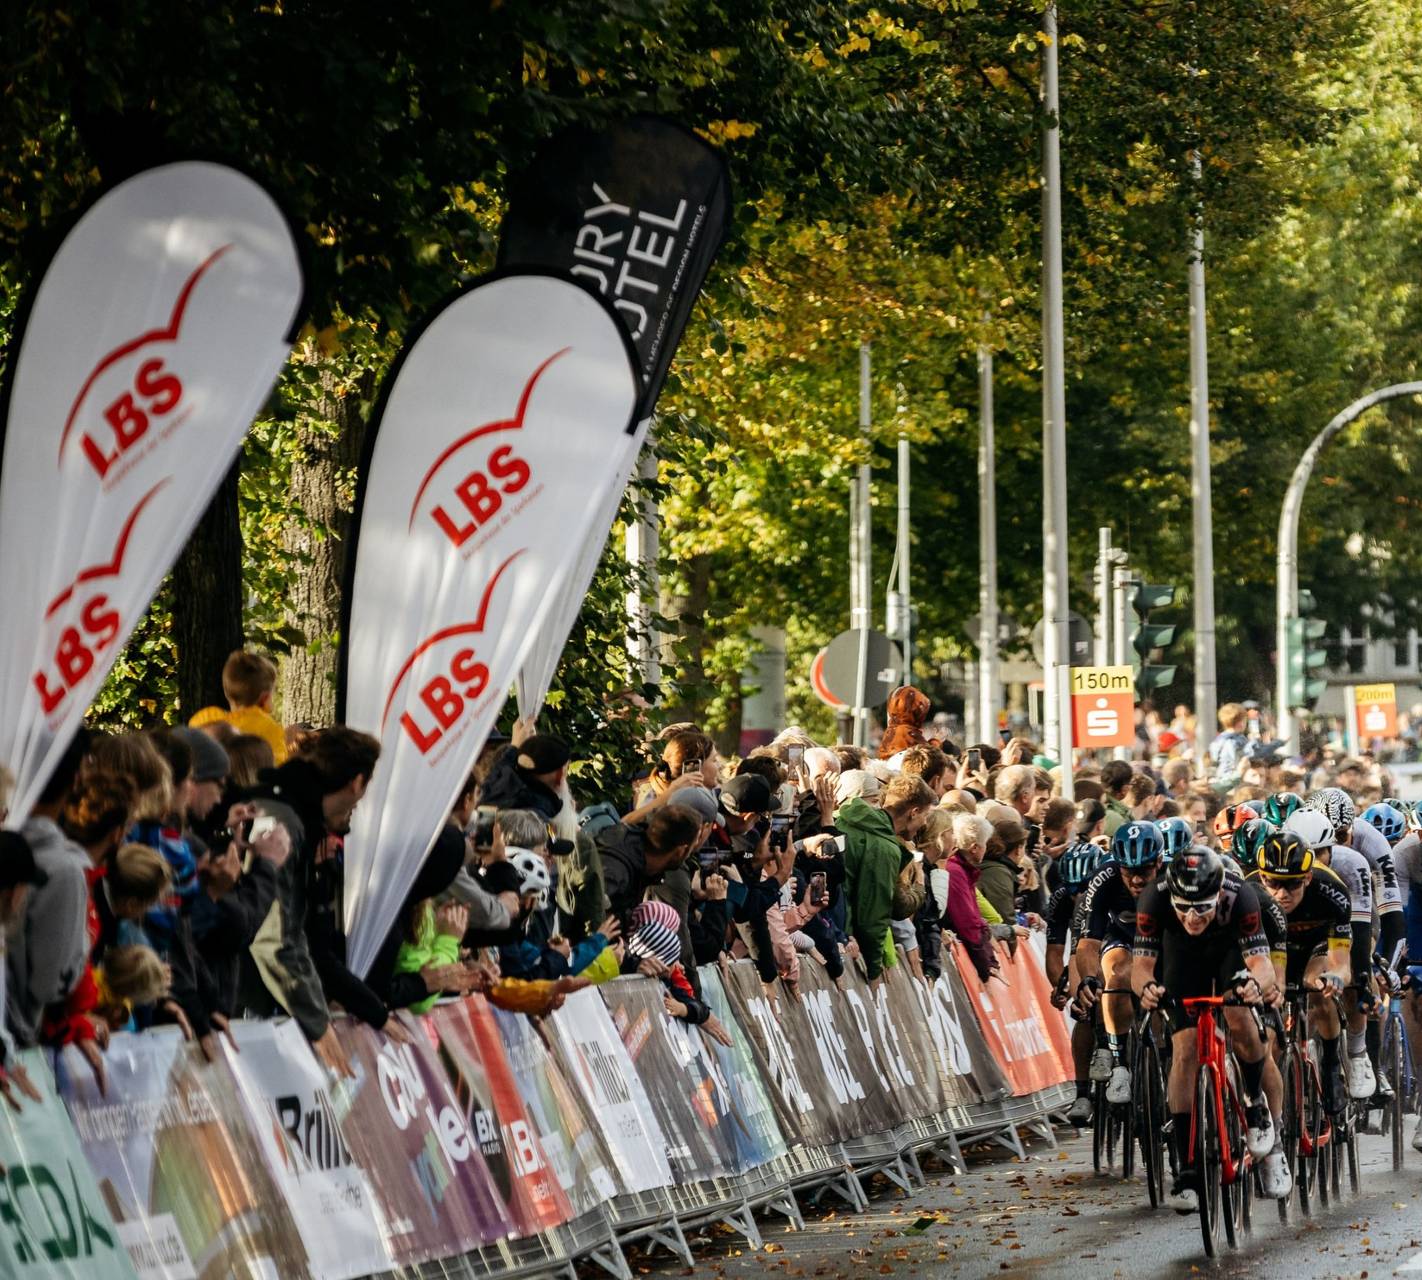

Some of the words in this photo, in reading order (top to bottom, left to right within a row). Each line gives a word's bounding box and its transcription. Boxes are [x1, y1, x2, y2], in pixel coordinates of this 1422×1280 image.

[80, 356, 183, 481] LBS
[431, 443, 531, 548] LBS
[33, 593, 121, 716] LBS
[400, 648, 491, 756] LBS
[1074, 672, 1129, 690] 150m
[1084, 866, 1115, 913] youfone
